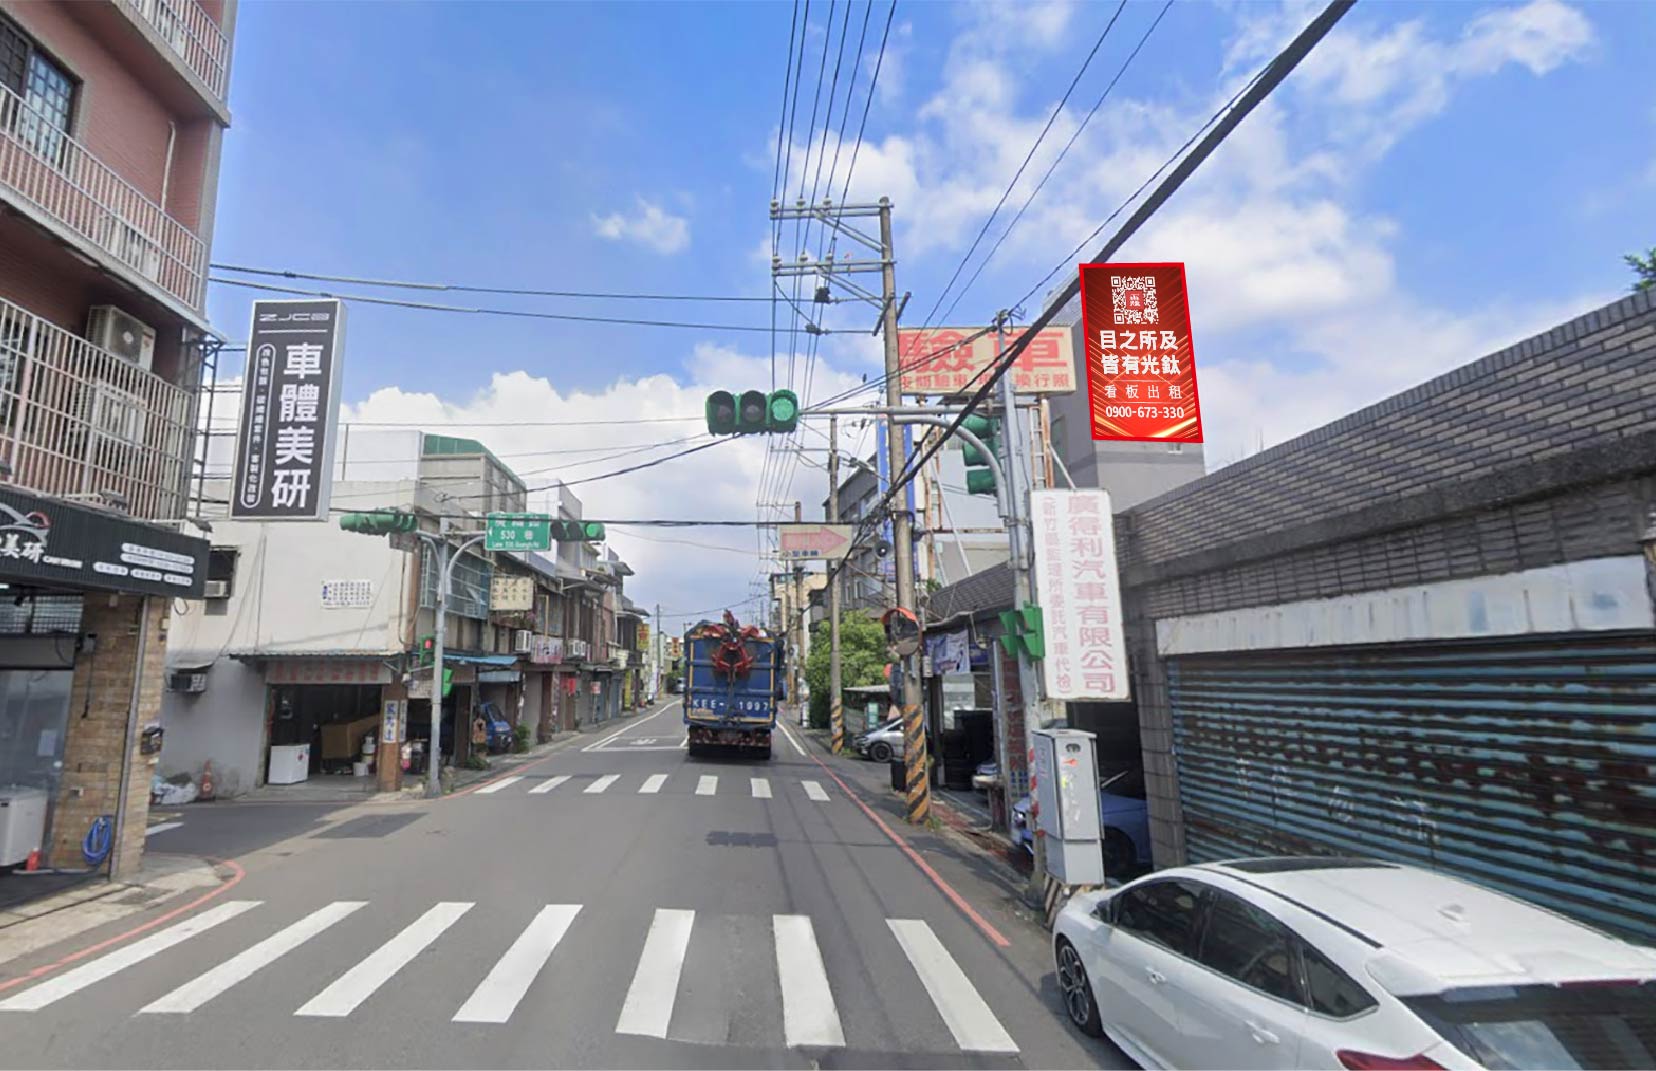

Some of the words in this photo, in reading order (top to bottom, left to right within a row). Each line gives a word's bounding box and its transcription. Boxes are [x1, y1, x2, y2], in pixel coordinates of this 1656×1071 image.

[1100, 330, 1178, 350] 目之所及
[898, 331, 1067, 372] 驗車
[1101, 354, 1181, 375] 皆有光鈦
[1104, 384, 1182, 399] 看板出租
[1105, 405, 1185, 419] 0900-673-330
[271, 342, 324, 508] 車體美研
[501, 530, 515, 540] 530
[0, 533, 45, 563] 美研
[1067, 494, 1116, 693] 廣得利汽車有限公司
